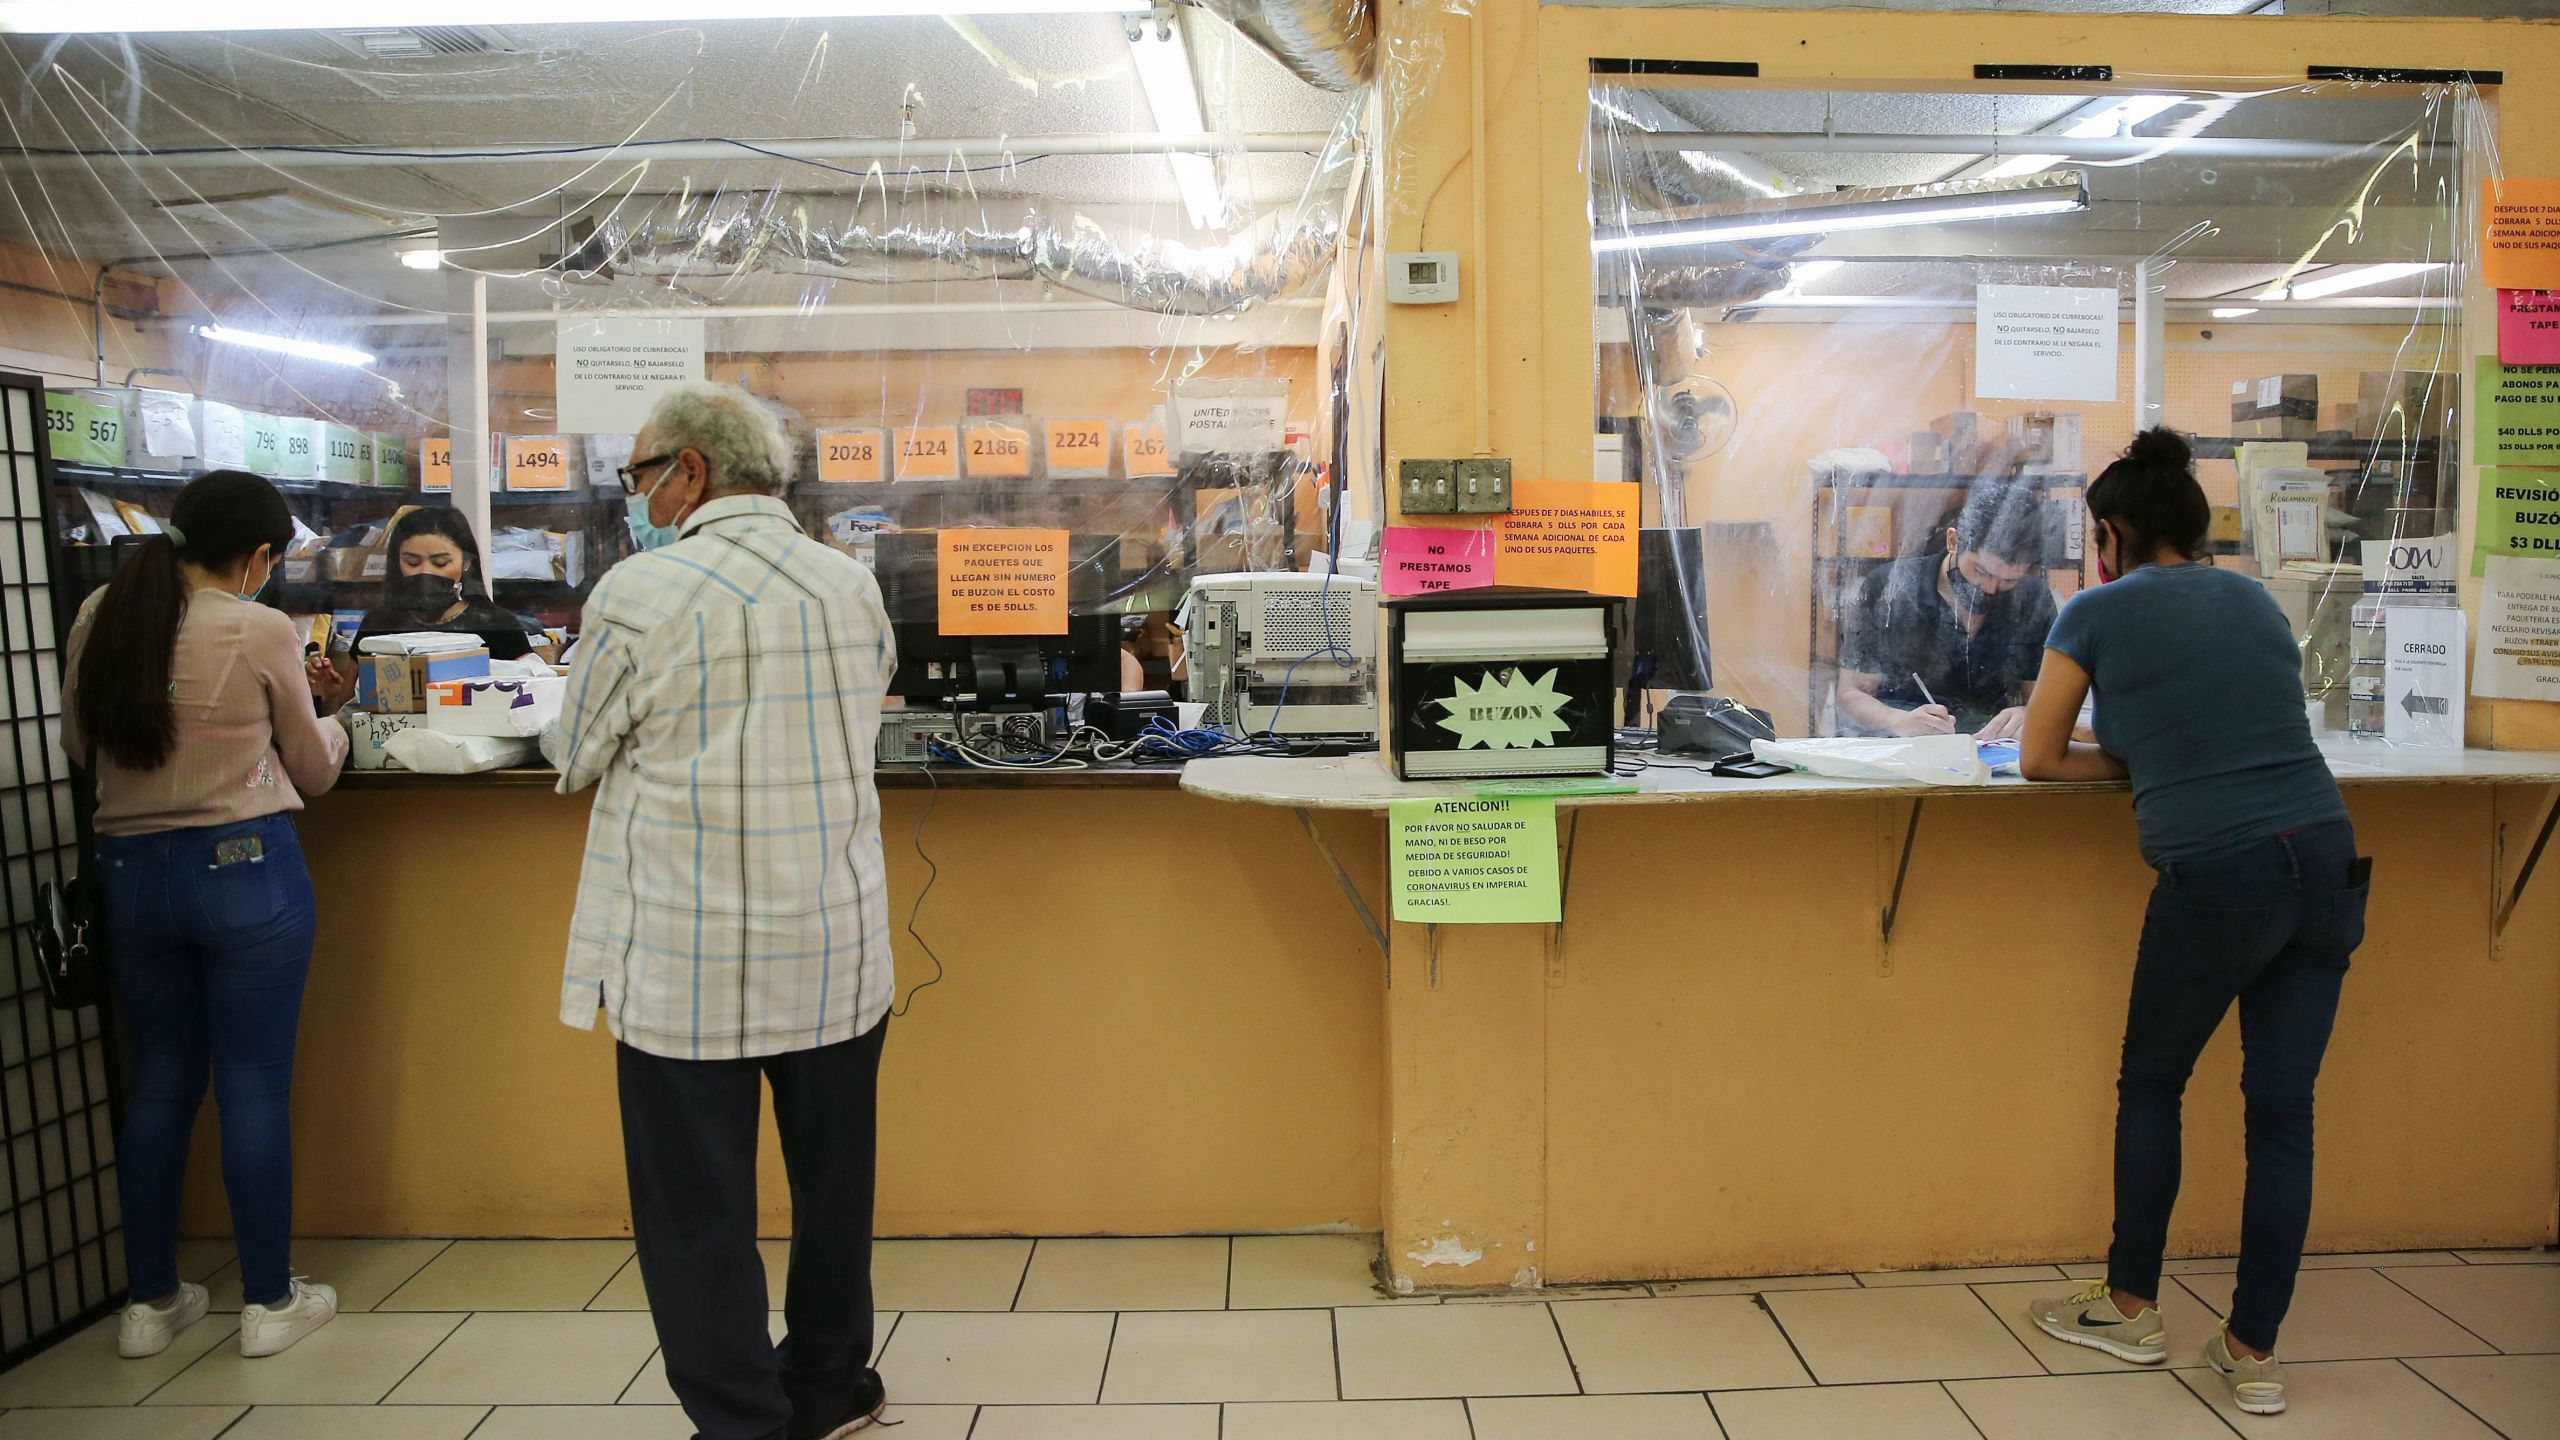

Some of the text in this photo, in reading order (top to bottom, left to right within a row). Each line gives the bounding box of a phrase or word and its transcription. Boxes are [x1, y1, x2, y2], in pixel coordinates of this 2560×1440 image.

[2494, 206, 2560, 214] DESPUES DE 7 DIA
[1997, 325, 2009, 333] NO
[2053, 326, 2065, 335] NO
[2530, 321, 2560, 329] TAPE
[577, 360, 589, 368] NO
[634, 360, 646, 368] NO
[2504, 366, 2533, 374] NO SE
[2495, 395, 2522, 403] PAGO
[2524, 395, 2538, 403] DE
[2540, 395, 2554, 403] SU
[1193, 408, 1230, 417] UNITED
[90, 421, 118, 442] 567
[2498, 428, 2515, 436] $40
[2518, 428, 2542, 436] DLLS
[256, 431, 275, 451] 796
[1055, 432, 1100, 448] 2224
[289, 437, 308, 455] 898
[331, 441, 355, 460] 1102
[903, 440, 947, 456] 2124
[974, 440, 1018, 456] 2186
[830, 446, 872, 461] 2028
[516, 452, 560, 468] 1494
[2496, 488, 2560, 502] REVISIÓ
[1542, 509, 1626, 518] DE 7 DIAS HABILES, SE
[2515, 512, 2560, 525] BUZÓ
[1505, 522, 1625, 530] COBRARA 5 DLLS POR CADA
[1505, 534, 1625, 542] SEMANA ADICIONAL DE CADA
[2510, 536, 2528, 549] $3
[953, 544, 1054, 552] SIN EXCEPCION LOS
[1505, 546, 1598, 556] UNO DE SUS PAQUETES.
[1400, 563, 1472, 573] PRESTAMOS
[950, 574, 1056, 582] LLEGAN SIN NUMERO
[1420, 581, 1450, 590] TAPE
[2498, 591, 2515, 599] PARA
[2516, 592, 2548, 600] PODERLE
[2508, 603, 2550, 612] ENTREGA DE
[2506, 615, 2550, 623] PAQUETERIA
[2492, 626, 2530, 634] NECESARIO
[2404, 643, 2446, 655] CERRADO
[2493, 648, 2526, 656] CONSIGO
[1469, 704, 1544, 722] BUZON
[1434, 800, 1510, 814] ATENCION!!
[1424, 824, 1454, 832] FAVOR
[1456, 824, 1470, 832] NO
[1472, 822, 1512, 830] SALUDAR
[1514, 822, 1526, 830] DE
[1405, 839, 1436, 848] MANO,
[1438, 838, 1448, 846] NI
[1450, 838, 1462, 846] DE
[1488, 836, 1506, 844] POR
[1406, 850, 1510, 861] MEDIDA DE SEGURIDAD!
[1408, 866, 1528, 877] DEBIDO A VARIOS CASOS DE
[1407, 880, 1528, 892] CORONAVIRUS EN IMPERIAL
